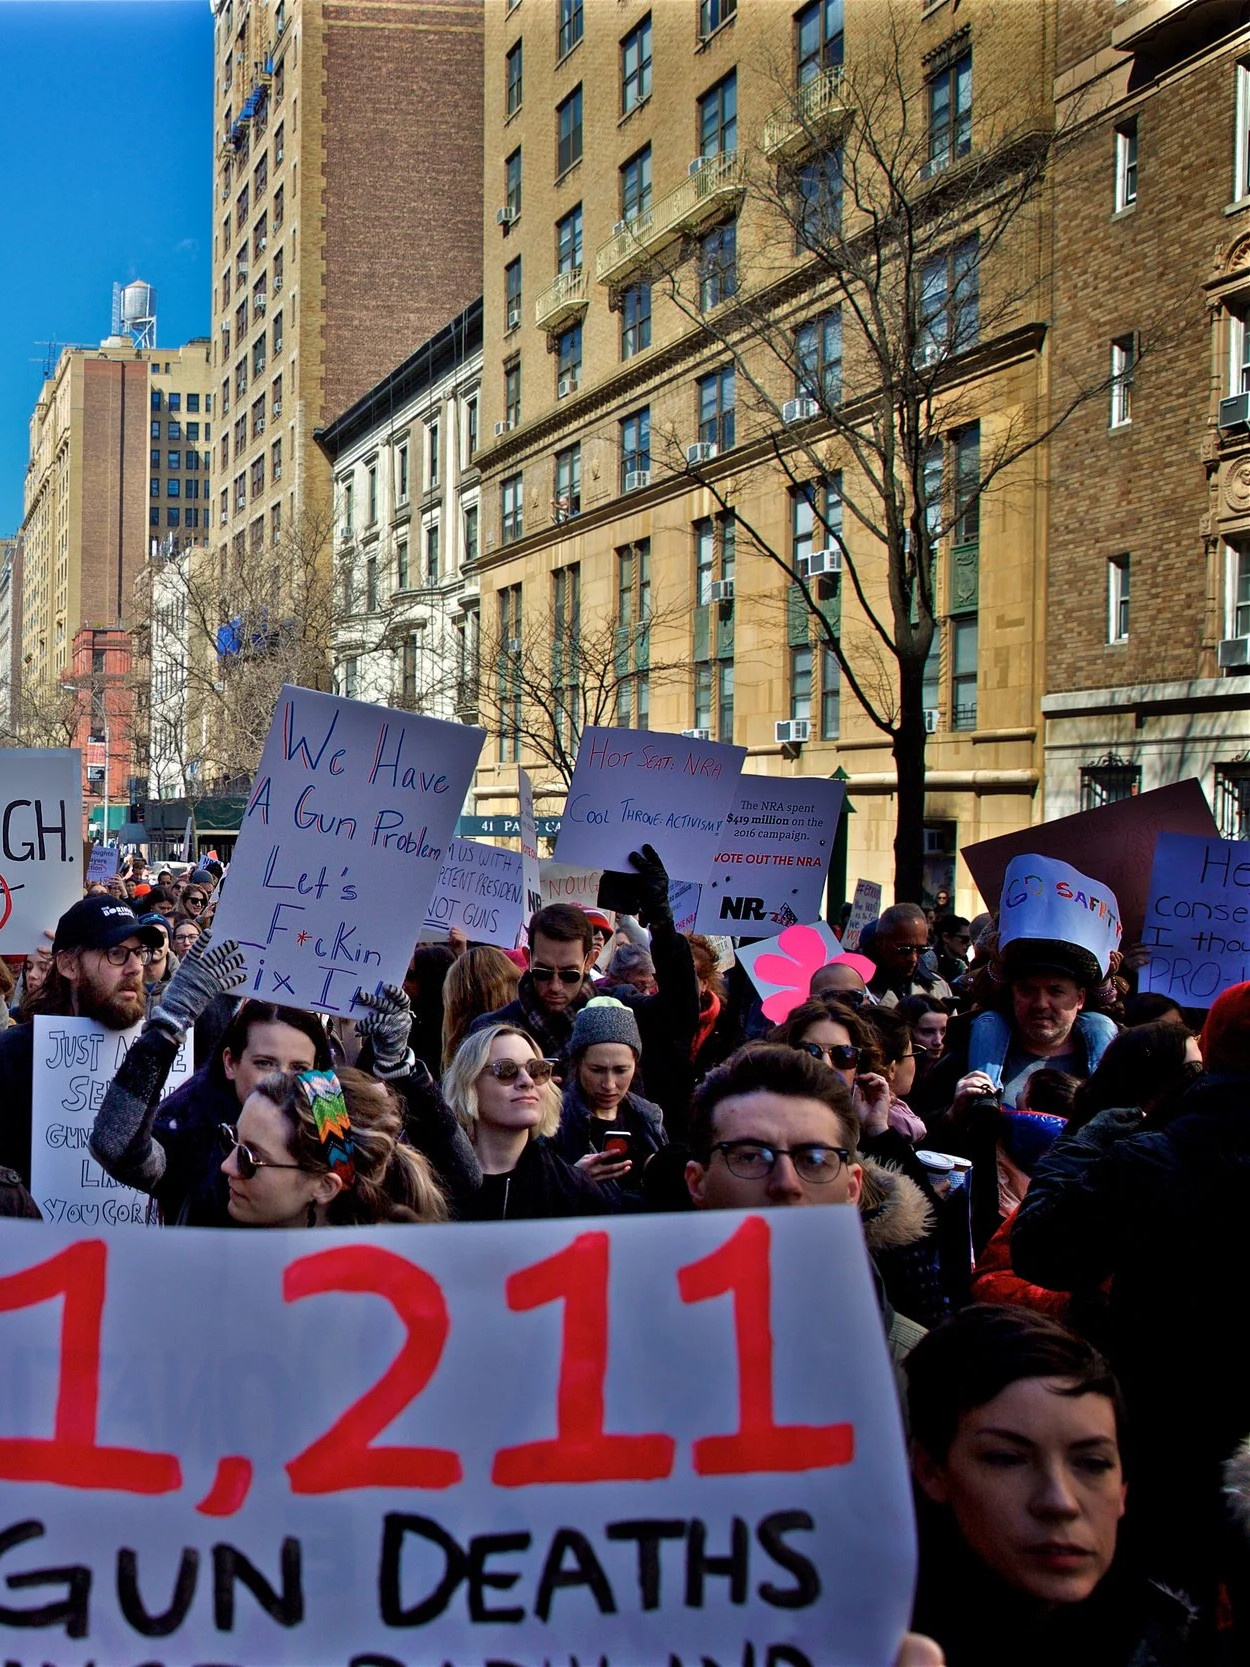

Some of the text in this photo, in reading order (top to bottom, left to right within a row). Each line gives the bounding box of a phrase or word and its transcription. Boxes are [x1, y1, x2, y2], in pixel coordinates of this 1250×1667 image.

[283, 701, 450, 794] We Have
[589, 736, 723, 779] HOT SEAT: NRA
[247, 776, 442, 861] A Gun Problem
[570, 794, 610, 825] COOL
[665, 812, 723, 837] ACTIVISM!
[727, 812, 823, 827] $419 million on the
[741, 800, 815, 814] The NRA spent
[481, 821, 494, 832] 41
[734, 829, 810, 841] 2016 campaign.
[262, 845, 358, 900] Let's
[458, 847, 474, 862] US
[478, 852, 512, 871] WITH
[714, 853, 822, 867] VOTE OUT THE NRA
[1006, 875, 1044, 908] GO
[463, 903, 500, 933] GUNS
[1146, 926, 1174, 948] I
[46, 1030, 105, 1072] JUST
[43, 1198, 100, 1227] YOU
[379, 1510, 822, 1628] DEATHS
